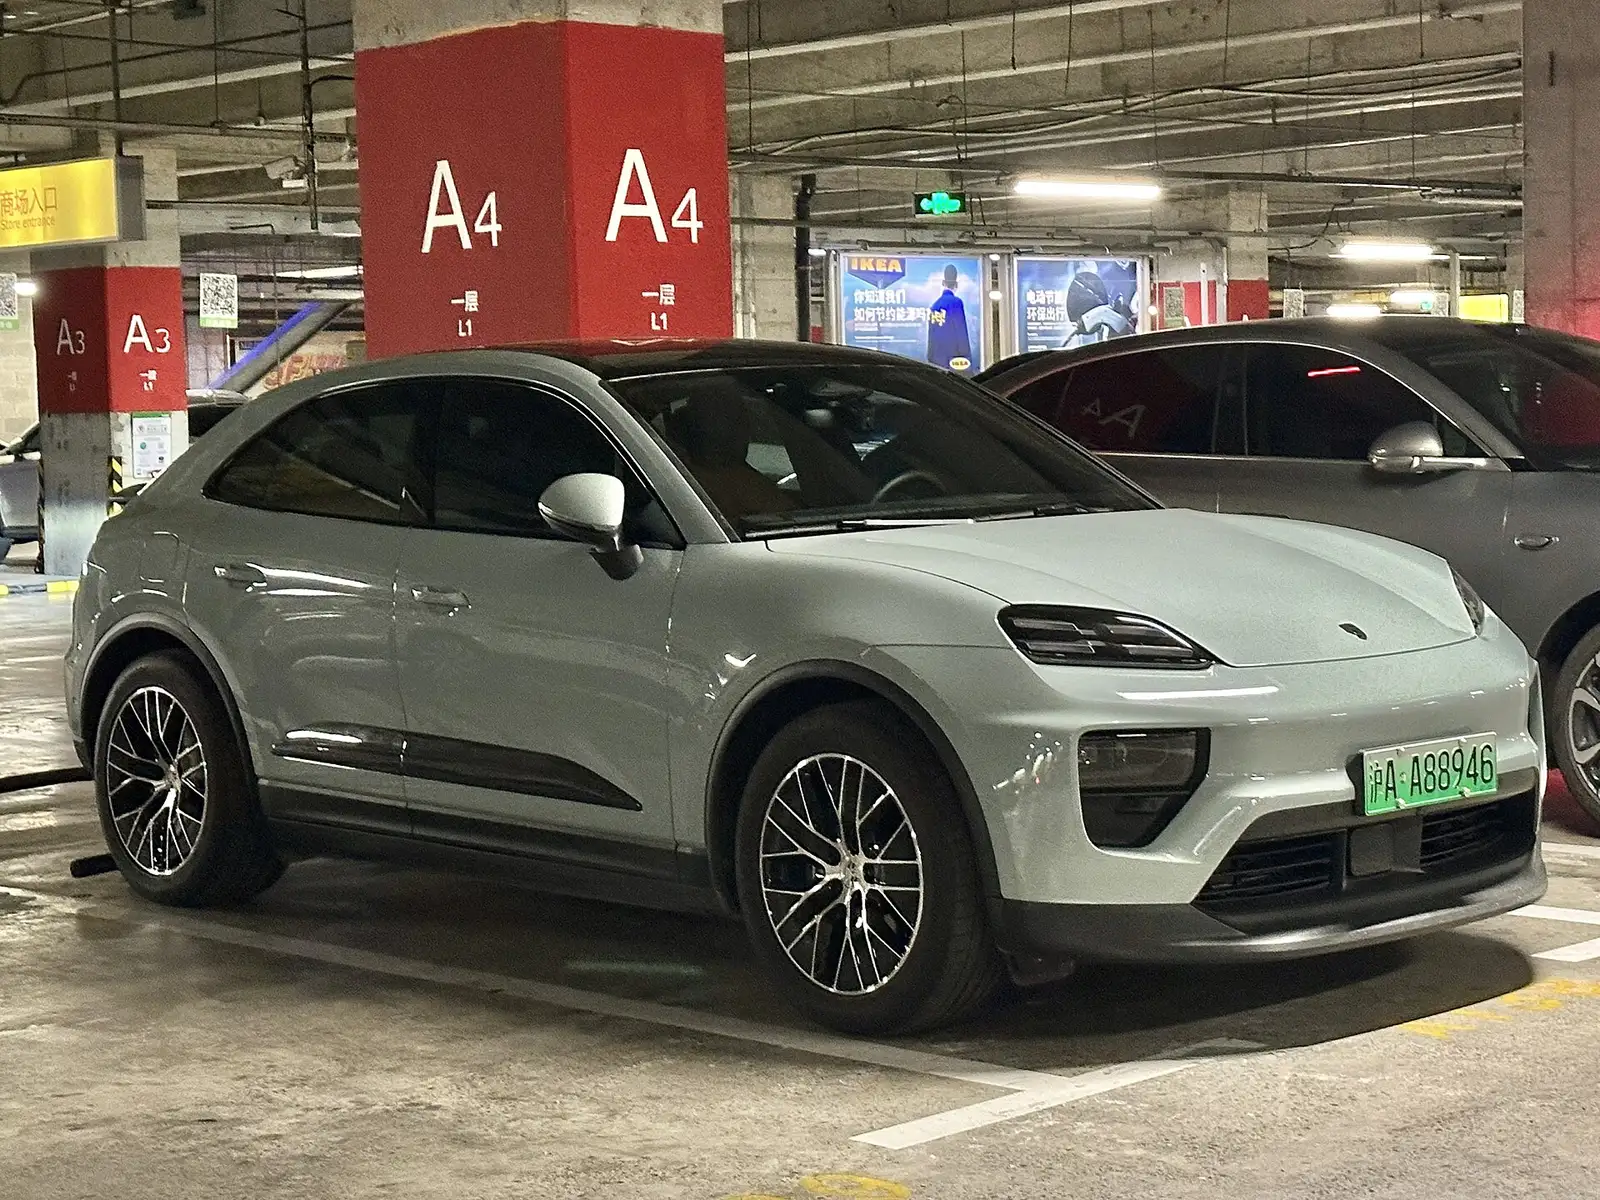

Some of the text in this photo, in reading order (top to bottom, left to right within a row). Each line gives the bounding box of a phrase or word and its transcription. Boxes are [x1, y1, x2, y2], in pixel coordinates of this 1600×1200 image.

[0, 187, 57, 217] 商场入口
[420, 159, 503, 254] A4
[604, 147, 705, 245] A4
[850, 257, 903, 273] IKEA
[450, 289, 480, 312] 一层
[641, 283, 676, 306] 一层
[123, 314, 172, 354] A3
[457, 318, 473, 337] L1
[650, 311, 669, 331] L1
[56, 318, 86, 356] A3
[1409, 741, 1495, 797] A88946
